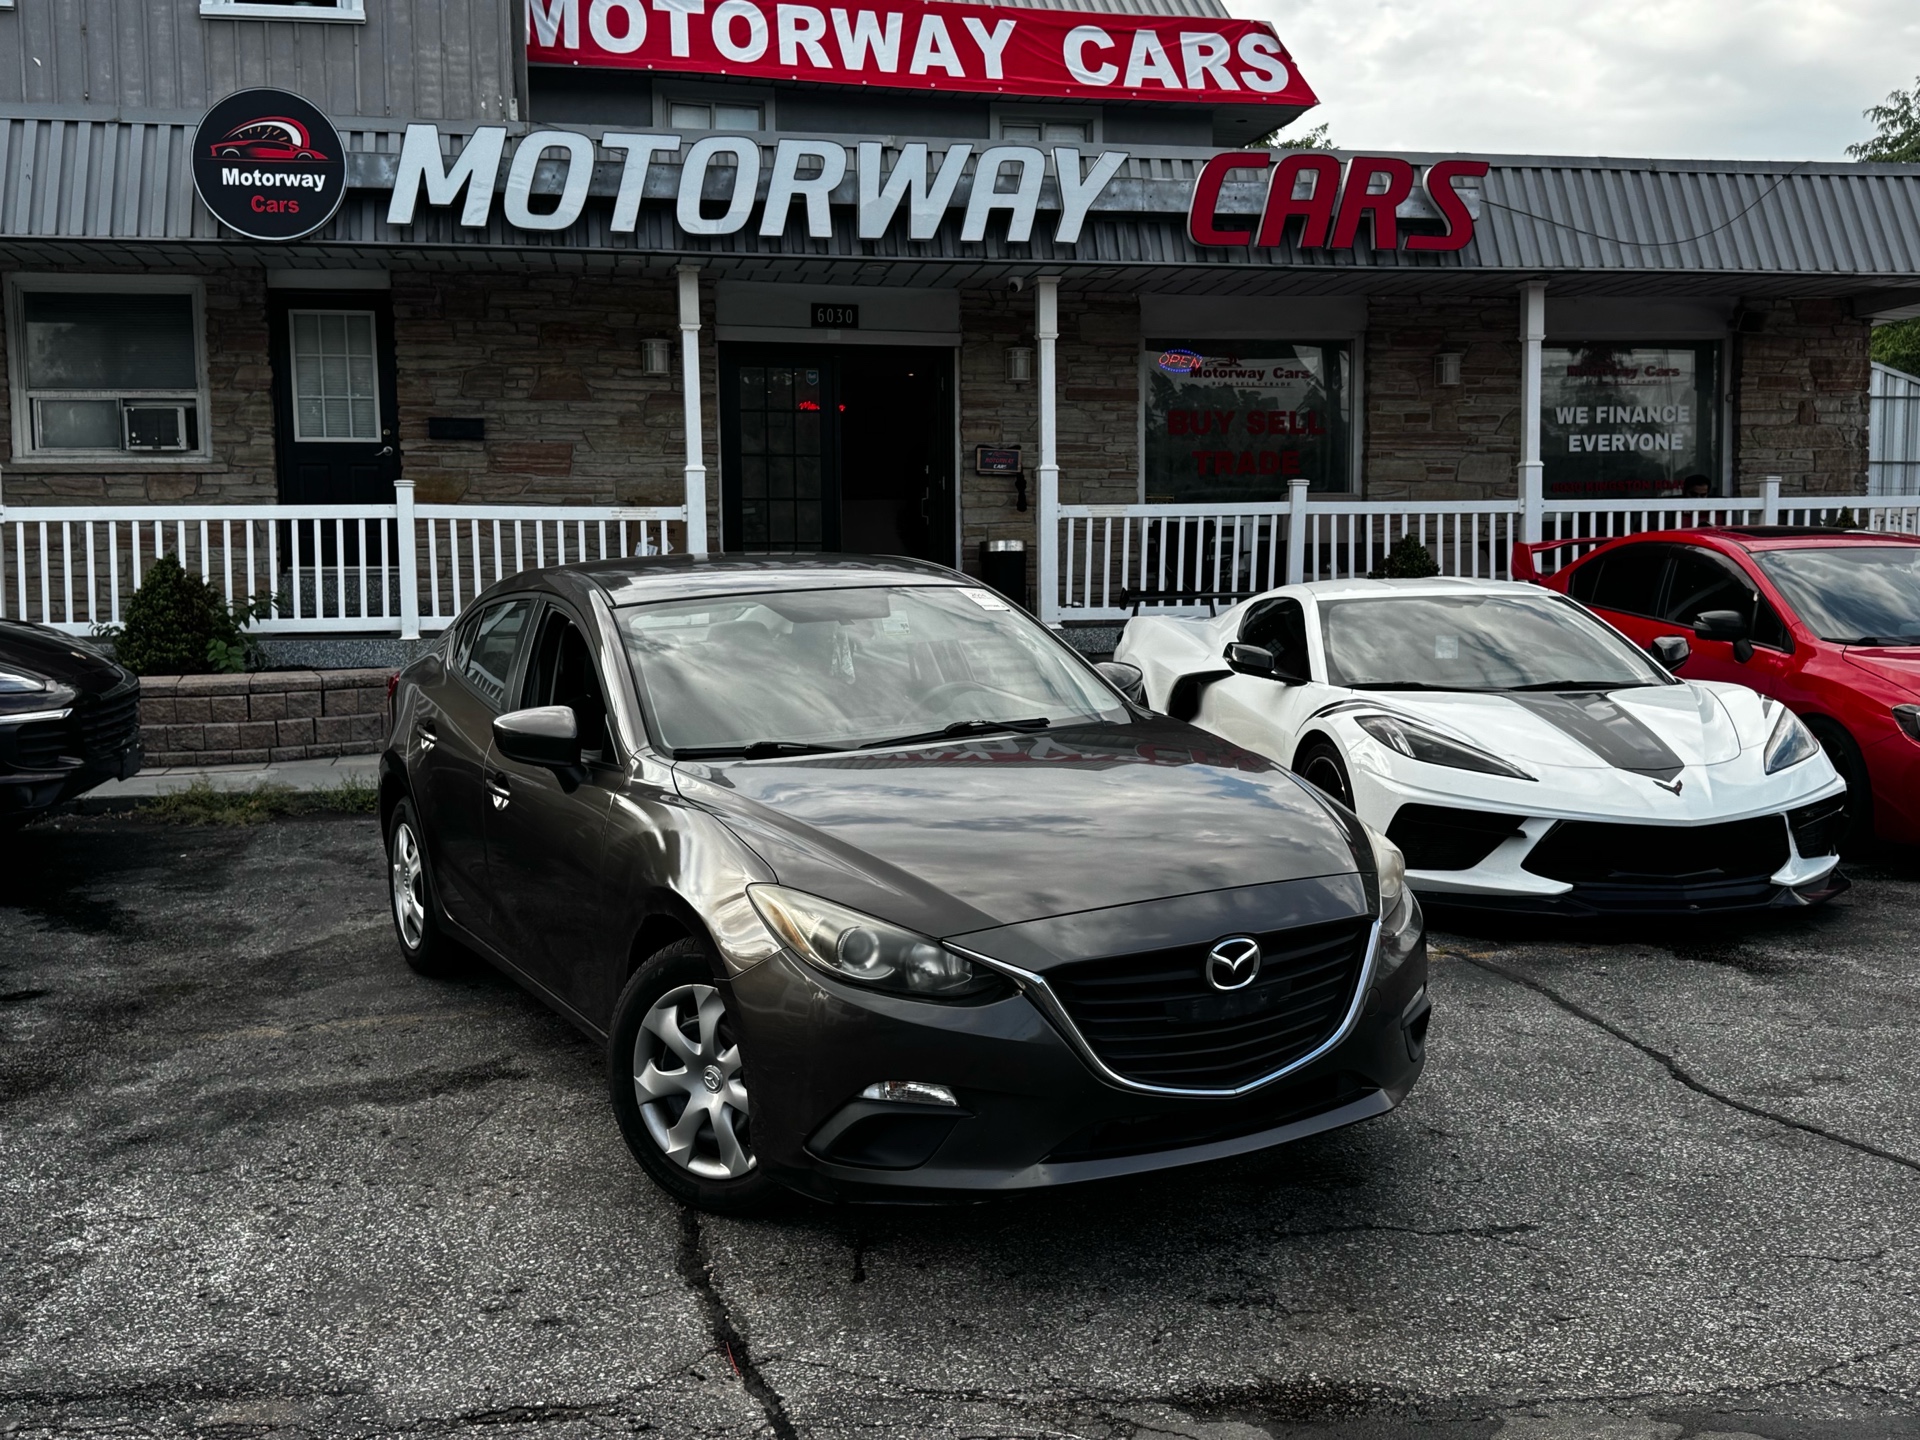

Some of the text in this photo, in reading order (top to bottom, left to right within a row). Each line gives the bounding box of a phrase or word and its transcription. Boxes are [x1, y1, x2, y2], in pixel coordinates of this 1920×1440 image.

[526, 0, 1291, 94] MOTORWAY CARS
[221, 168, 326, 192] Motorway
[386, 122, 1490, 251] MOTORWAY CARS
[251, 195, 300, 213] Cars
[817, 308, 853, 324] 6030
[1158, 352, 1204, 370] OPEN
[1190, 367, 1310, 381] Motorway Cars
[1644, 365, 1680, 377] Cars
[1168, 410, 1327, 436] BUY SELL
[1555, 405, 1690, 425] WE FINANCE
[1568, 433, 1684, 453] EVERYONE
[1191, 450, 1302, 475] TRADE
[1585, 480, 1652, 492] KINGSTON
[650, 526, 676, 535] VEOR
